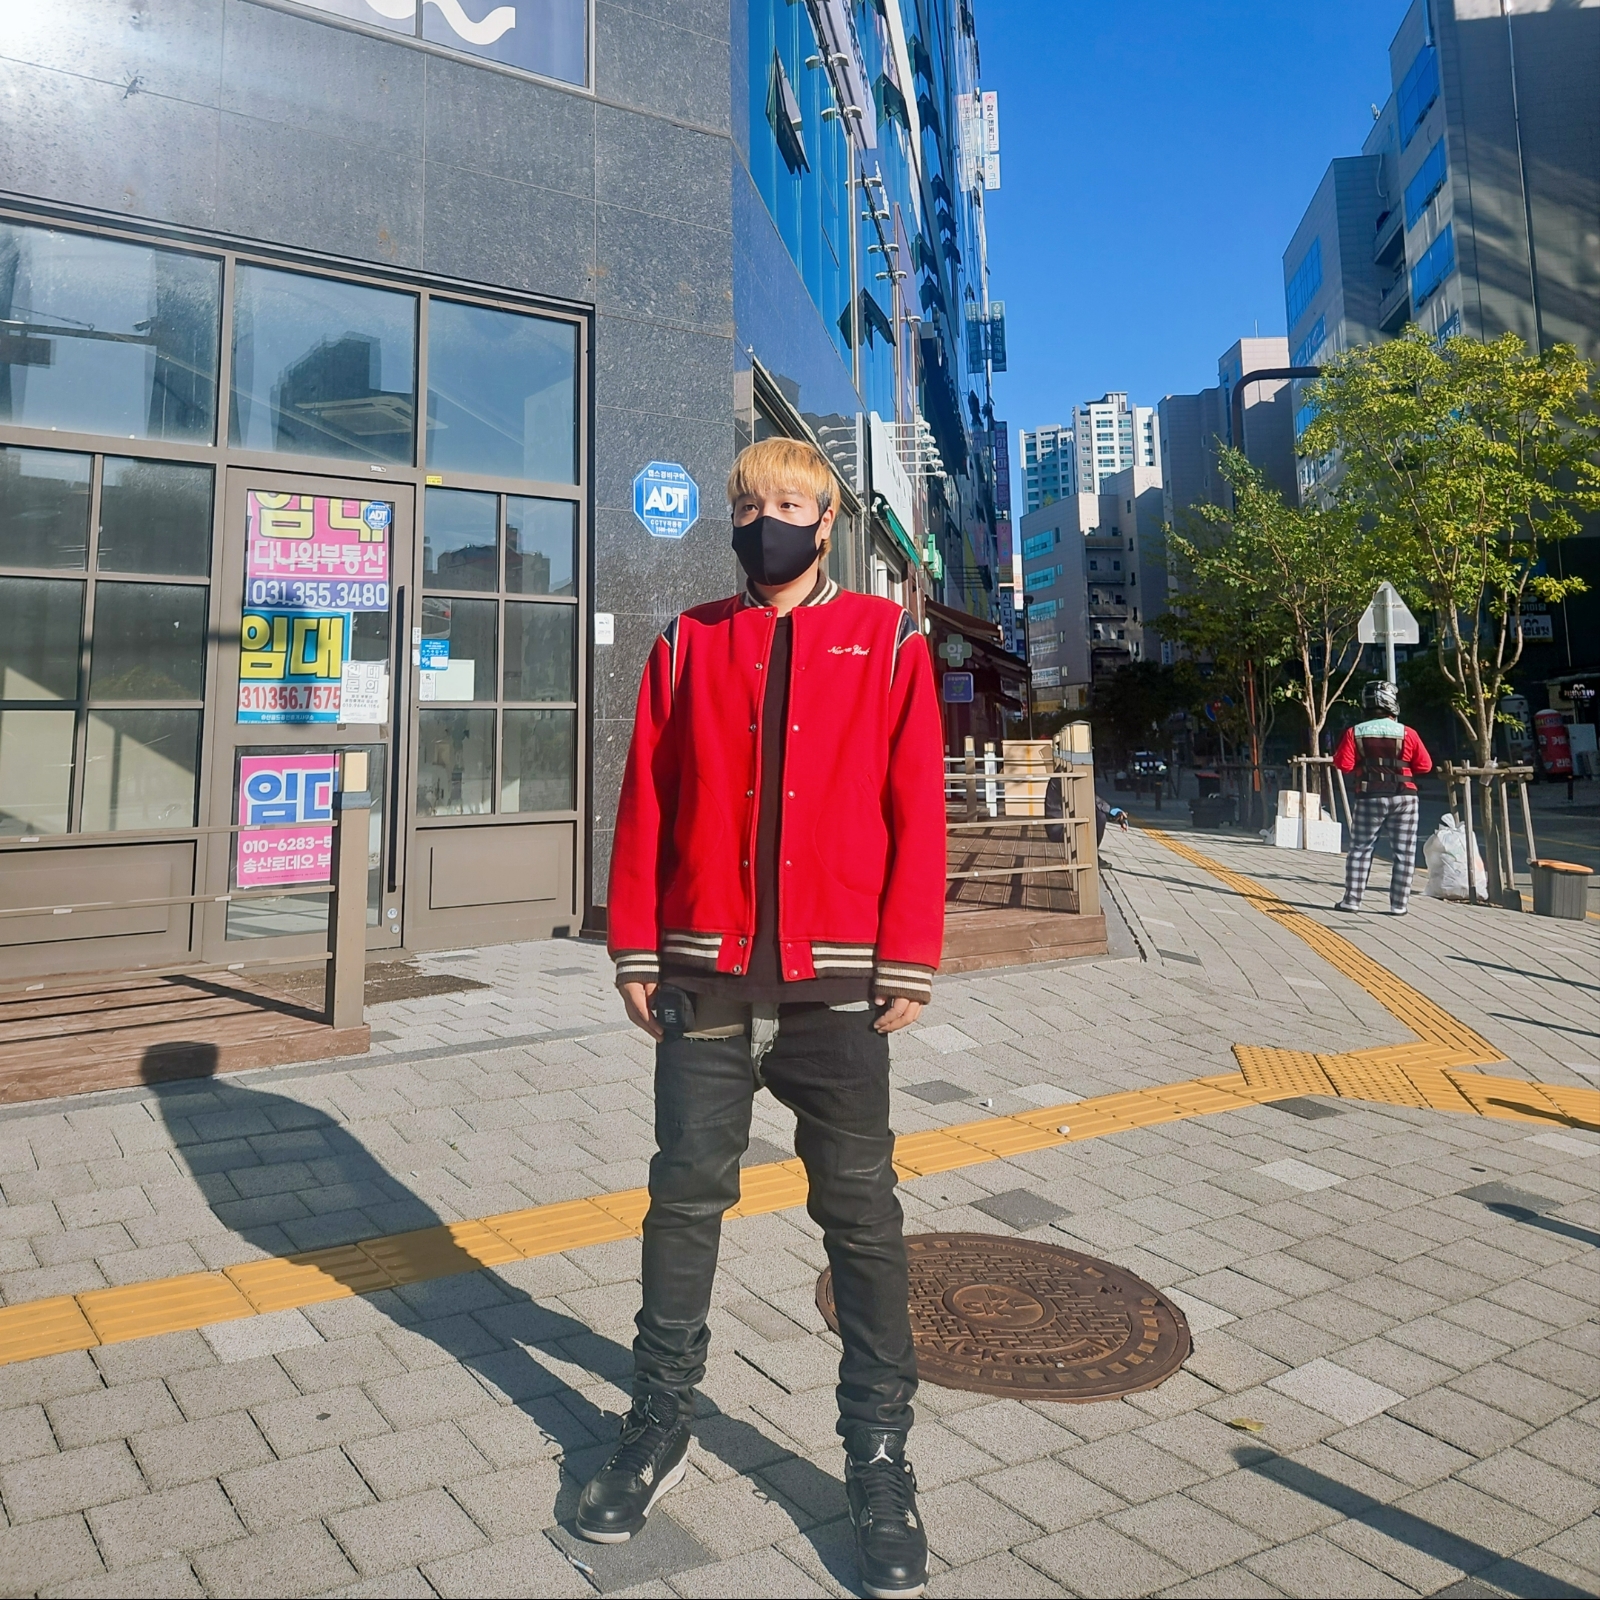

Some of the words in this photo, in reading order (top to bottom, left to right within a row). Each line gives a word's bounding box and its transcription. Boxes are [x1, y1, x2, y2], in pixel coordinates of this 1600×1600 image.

[645, 486, 688, 514] ADT
[368, 510, 388, 521] ADT
[253, 540, 386, 575] 다나와부동산
[251, 580, 389, 607] 031.355.3480
[240, 614, 344, 680] 임대
[946, 643, 963, 661] 약
[238, 686, 340, 711] 31)356.7575
[243, 854, 315, 873] 송산로데오
